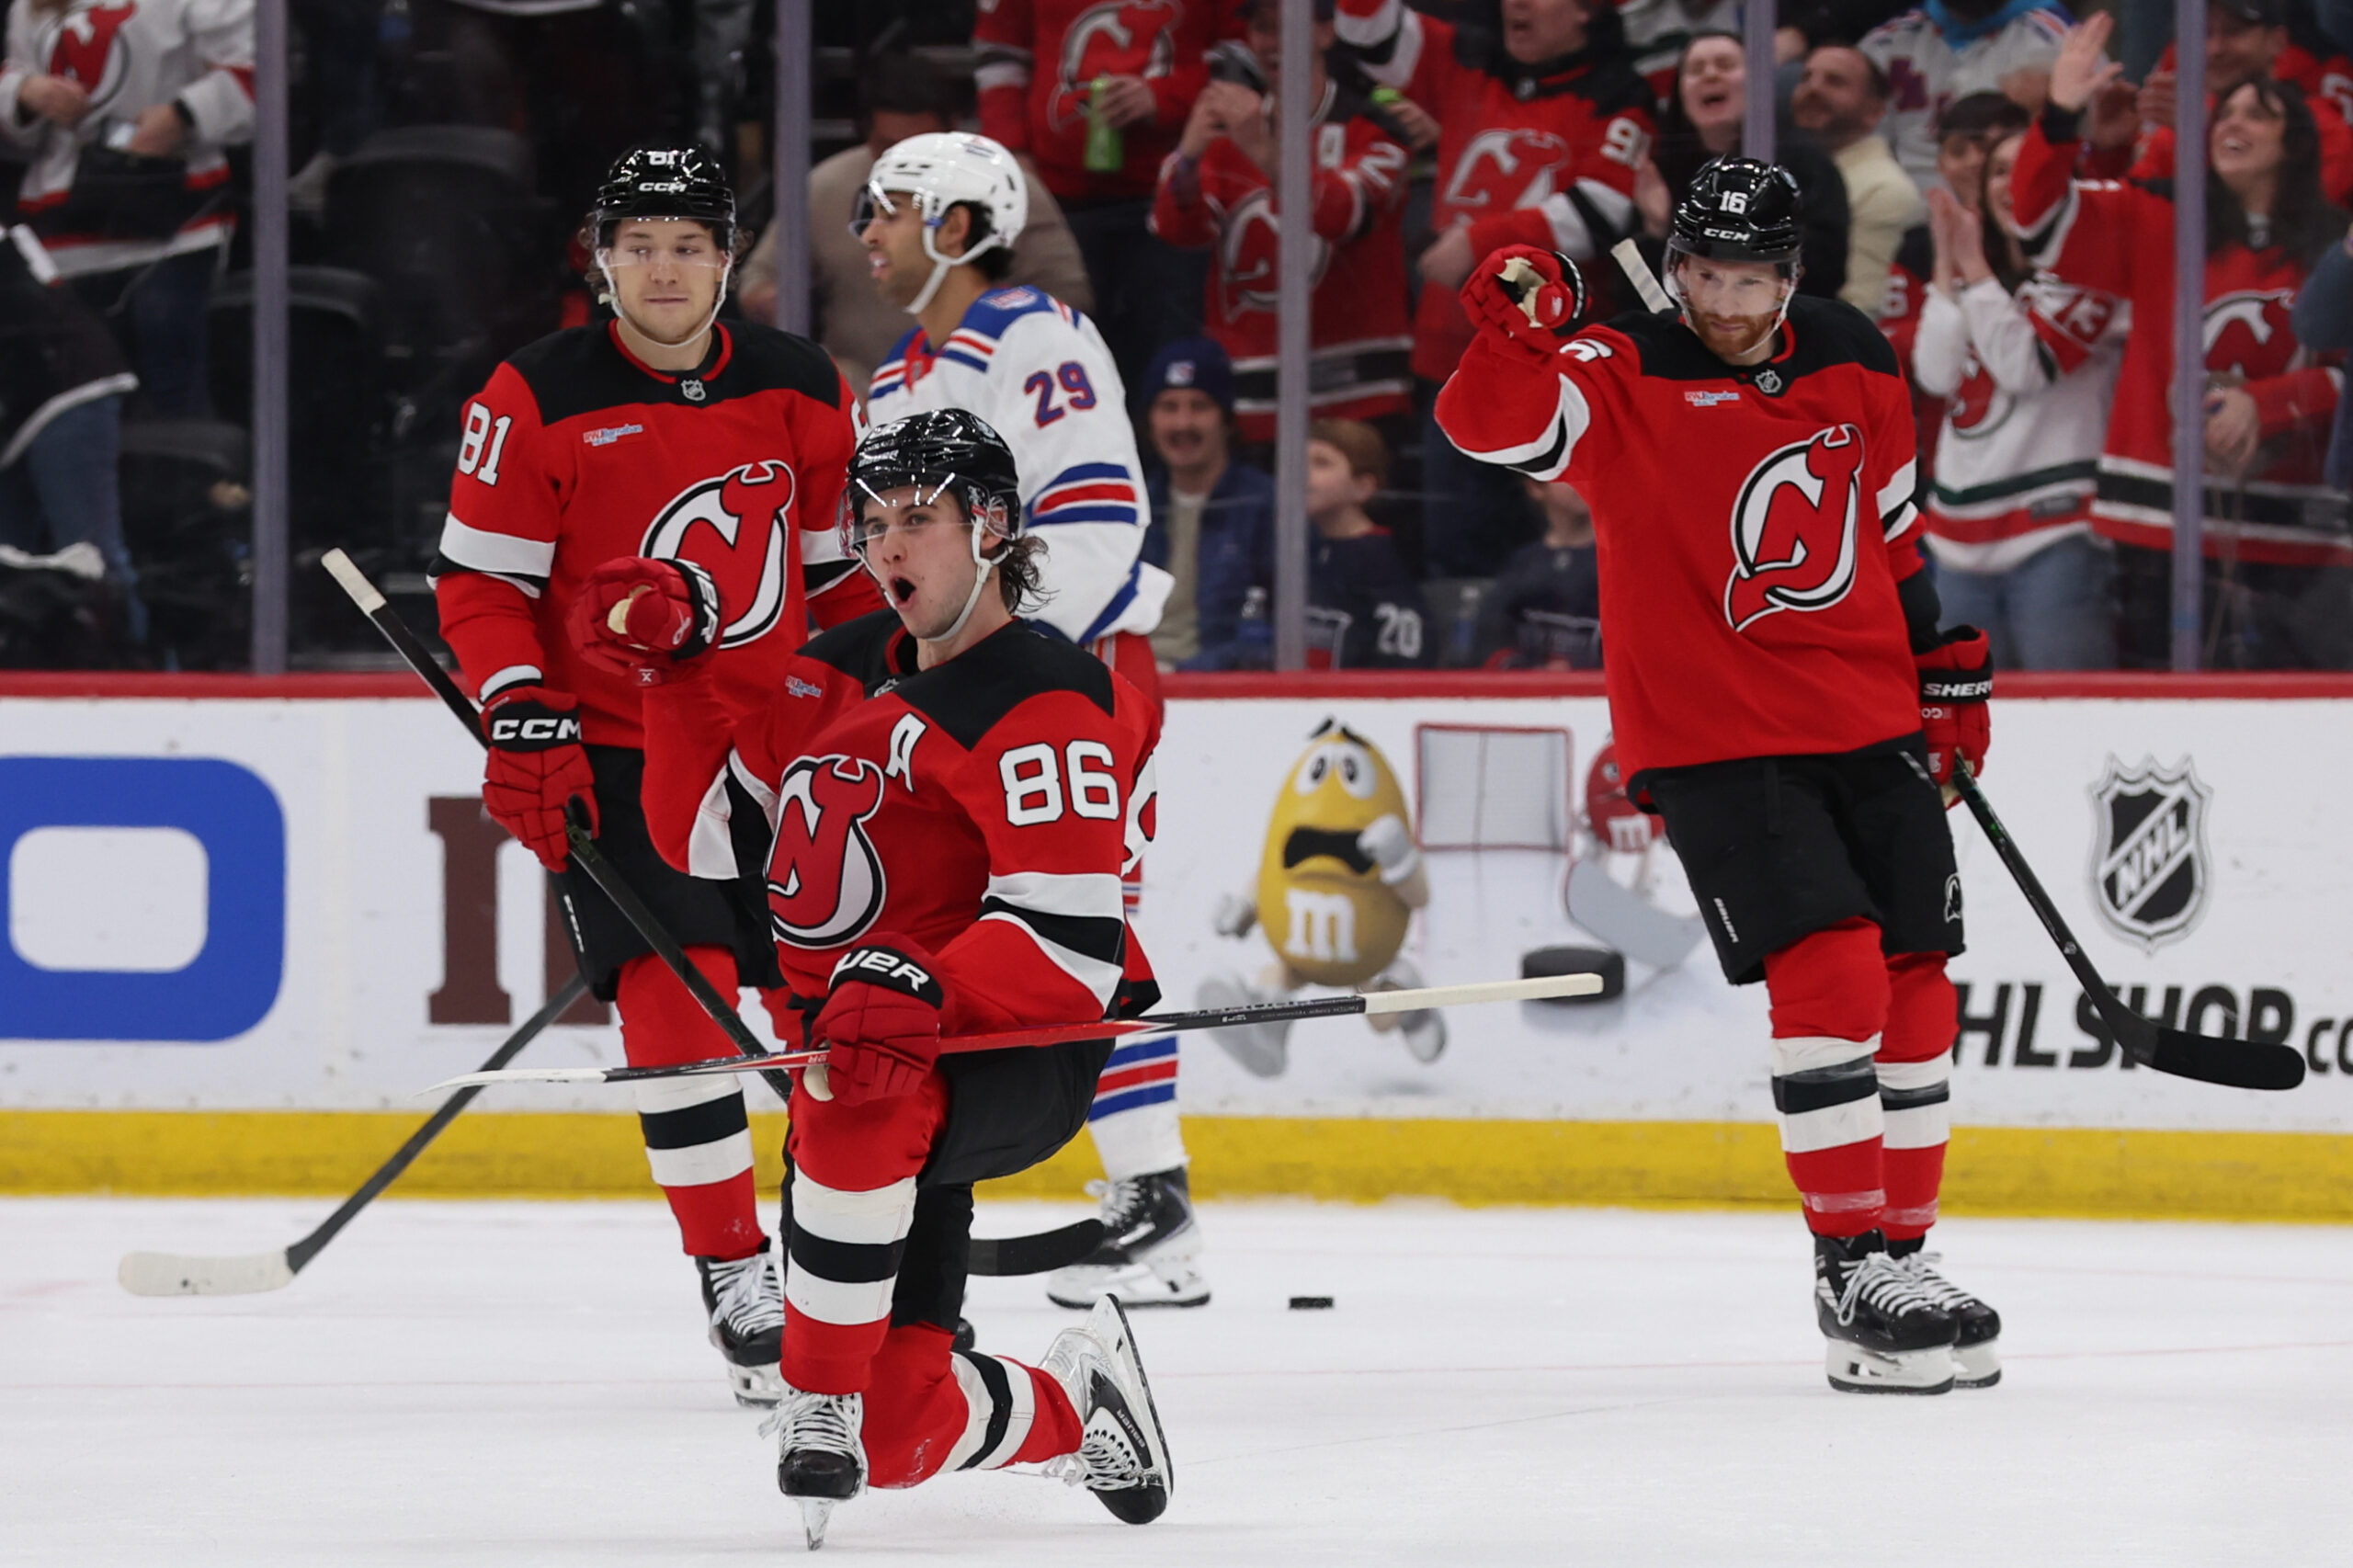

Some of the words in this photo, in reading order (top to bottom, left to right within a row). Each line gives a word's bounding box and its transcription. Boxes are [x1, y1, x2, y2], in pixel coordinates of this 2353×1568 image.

[638, 182, 688, 192] CCM
[1719, 189, 1749, 215] 16
[1702, 227, 1751, 242] CCM
[1023, 359, 1097, 430] 29
[457, 401, 514, 486] 81
[1374, 602, 1423, 660] 20
[1922, 679, 1993, 698] SHER
[492, 719, 583, 741] CCM
[884, 711, 928, 794] A
[998, 738, 1120, 828] 86
[2115, 807, 2188, 909] NHL
[1283, 888, 1360, 964] m
[828, 949, 930, 992] UER
